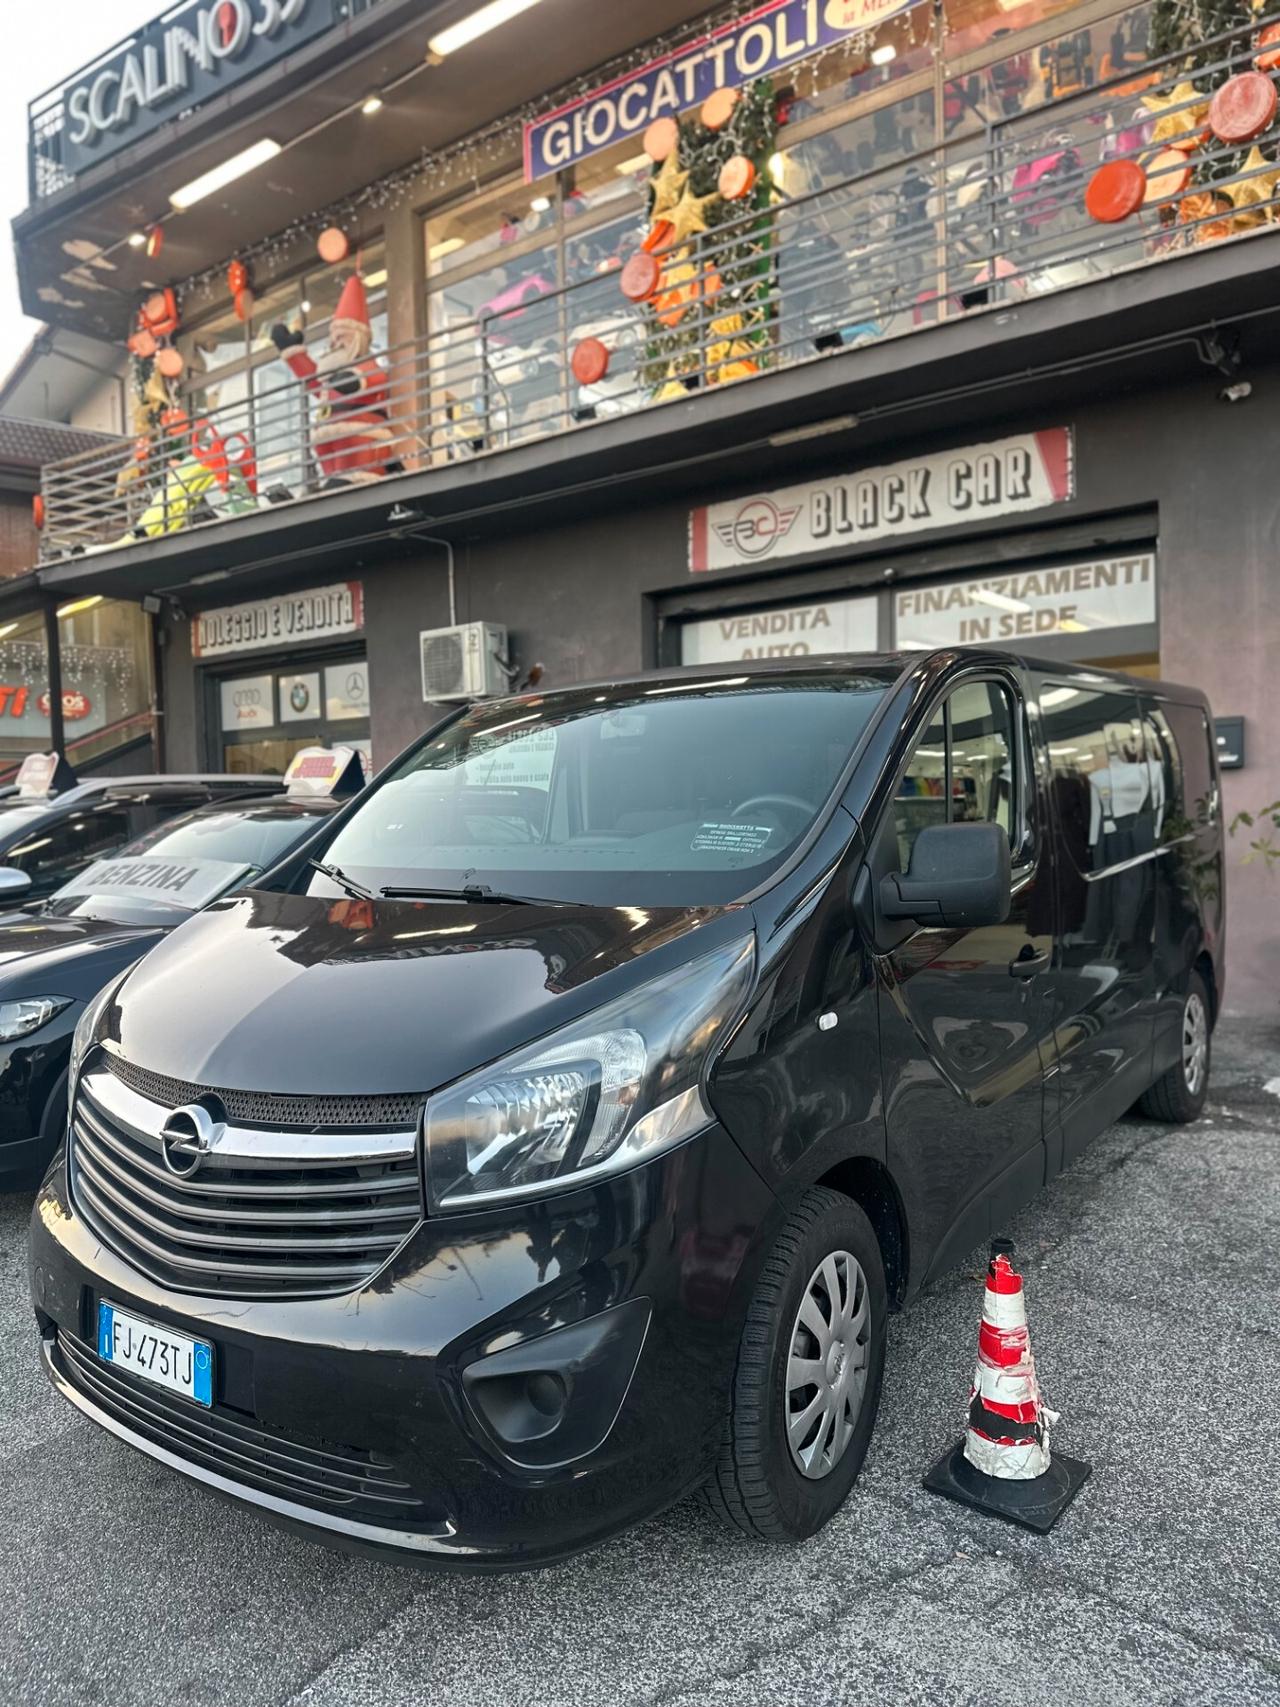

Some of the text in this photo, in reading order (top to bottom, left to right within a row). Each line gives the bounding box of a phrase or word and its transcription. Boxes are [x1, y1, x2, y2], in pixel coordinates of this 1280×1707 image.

[541, 0, 819, 166] GIOCATTOLI
[809, 447, 1032, 539] BLACK CAR
[897, 557, 1150, 617] FINANZIAMENTI
[201, 590, 355, 649] NOLEGGIO E VENDITA
[720, 606, 831, 641] VENDITA
[960, 605, 1078, 641] IN SEDE
[87, 865, 199, 891] BENZINA
[113, 1321, 192, 1384] FJ473TJ
